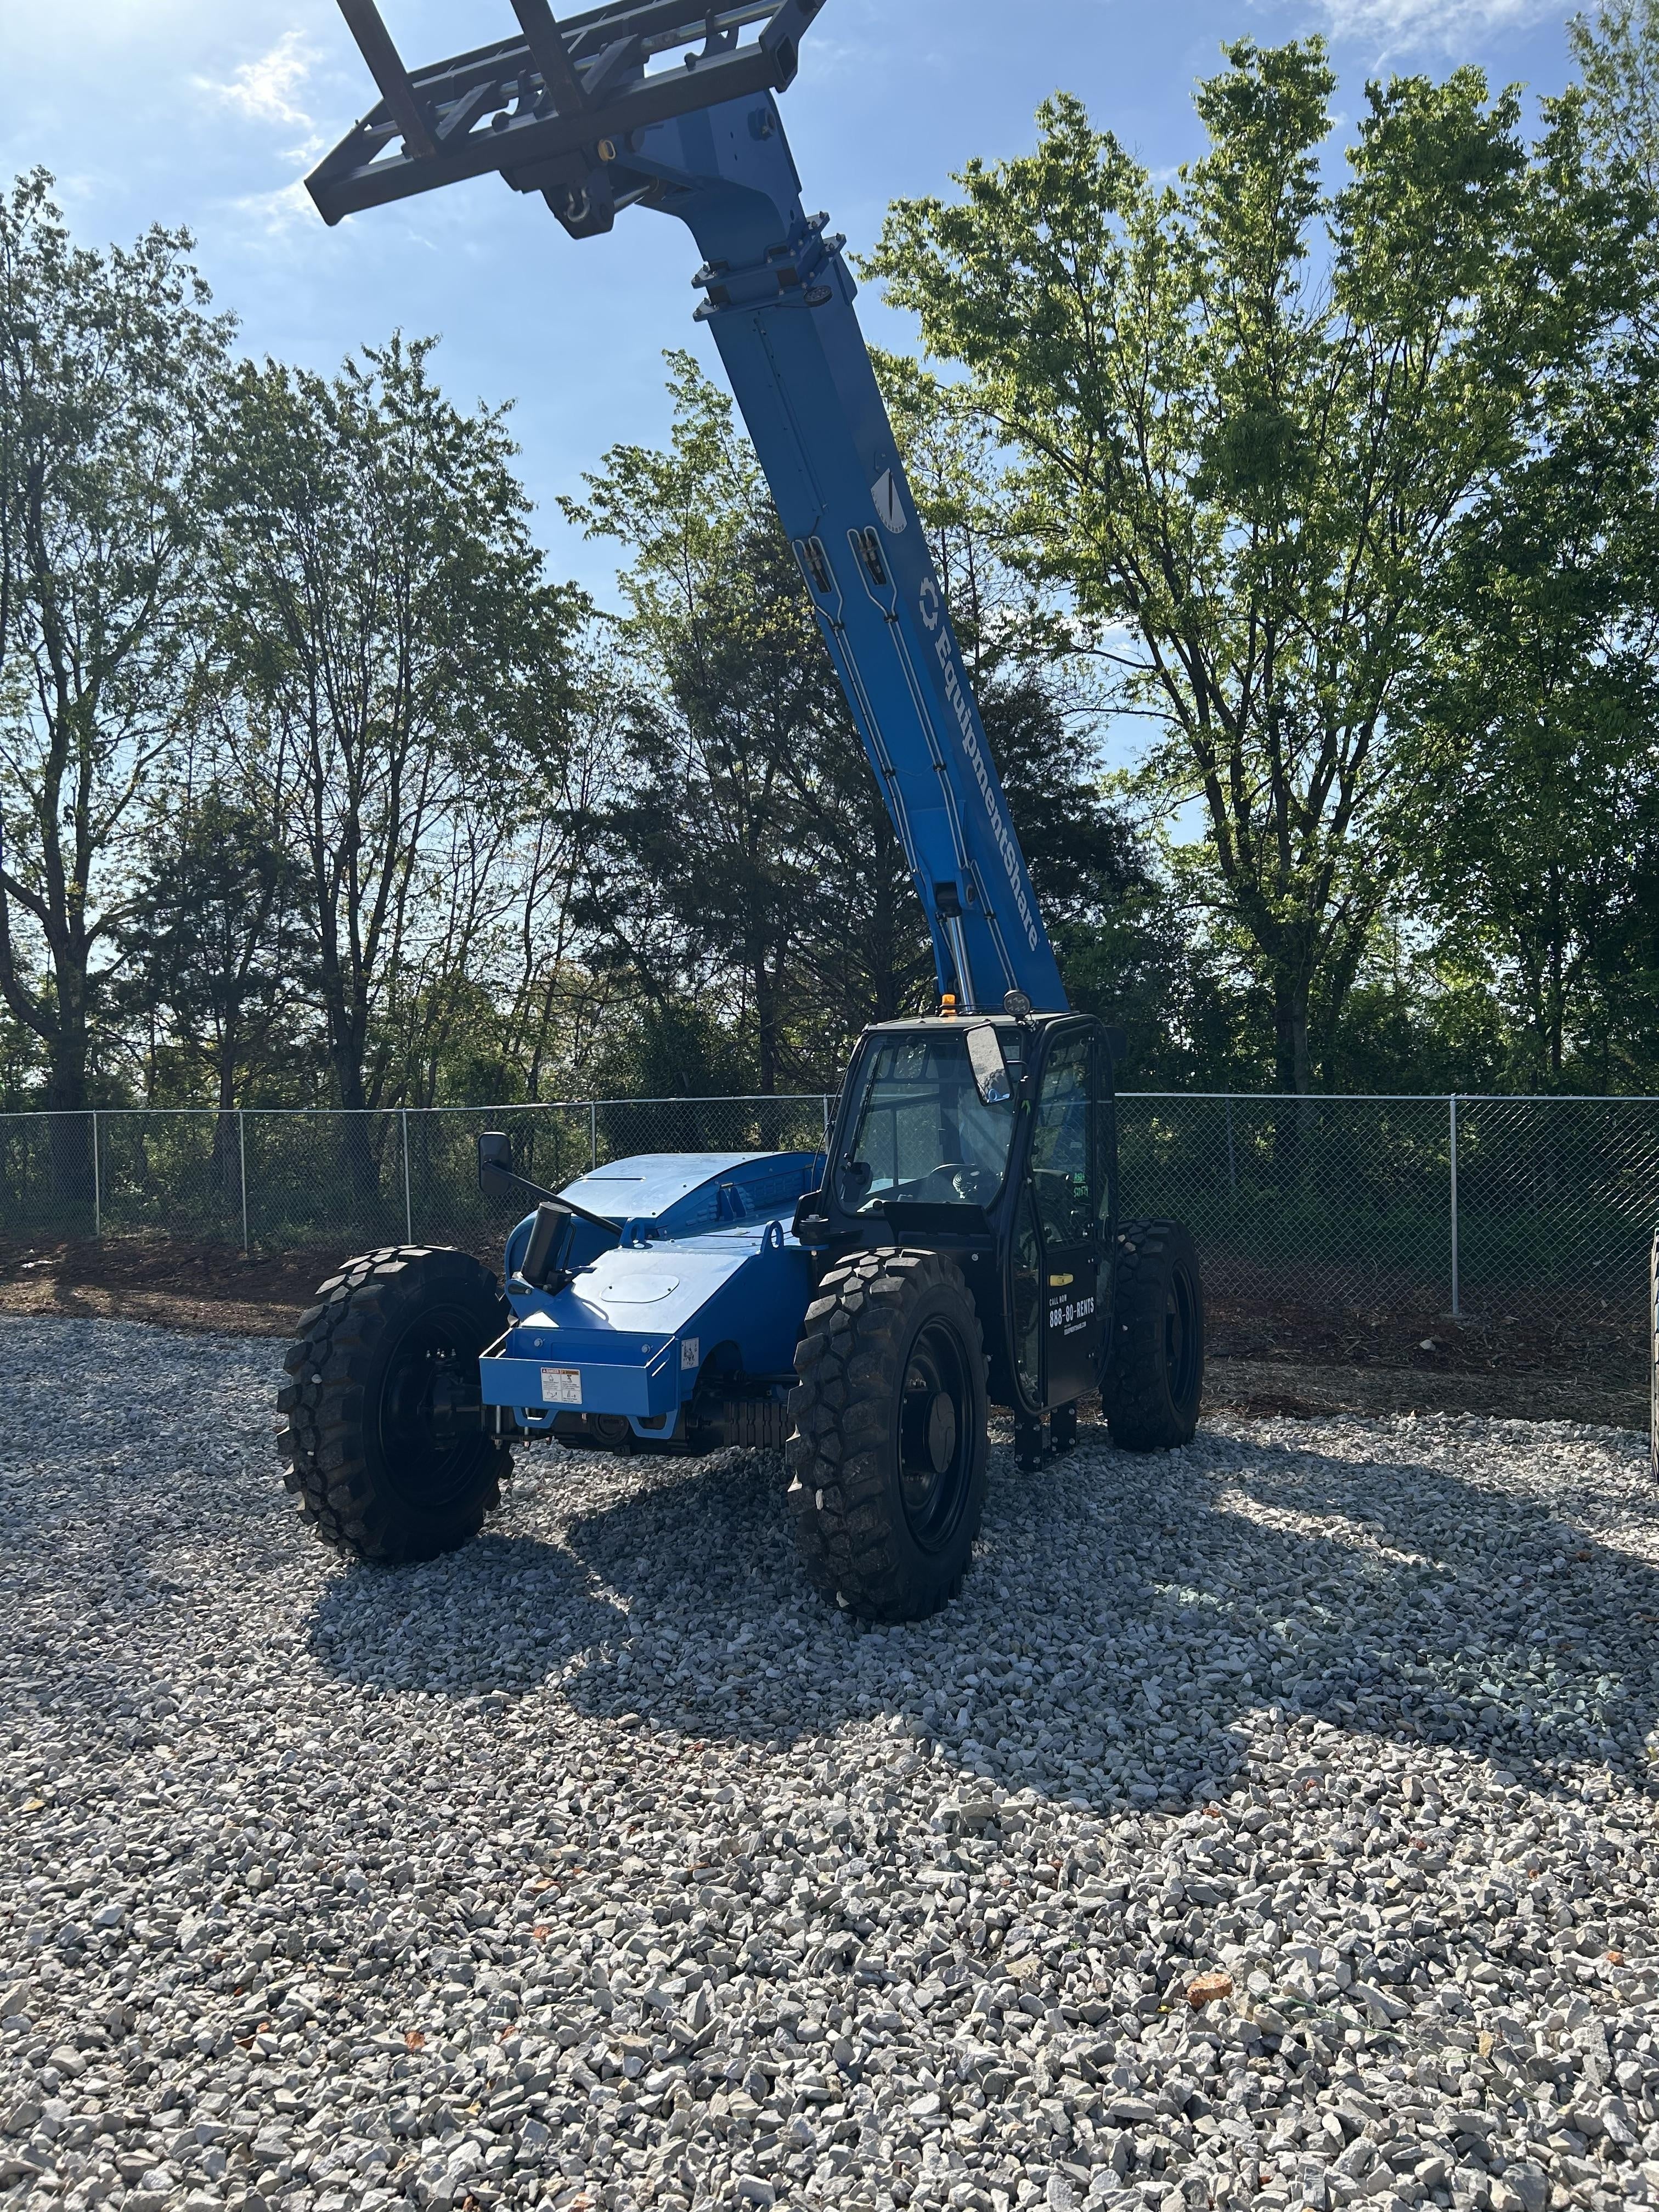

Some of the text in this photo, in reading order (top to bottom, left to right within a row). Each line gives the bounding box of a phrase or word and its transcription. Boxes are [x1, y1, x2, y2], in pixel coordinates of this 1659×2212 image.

[935, 625, 1037, 952] EquipmentShare
[1049, 1297, 1058, 1306] CALL
[1049, 1297, 1094, 1328] 888-80-RENTS
